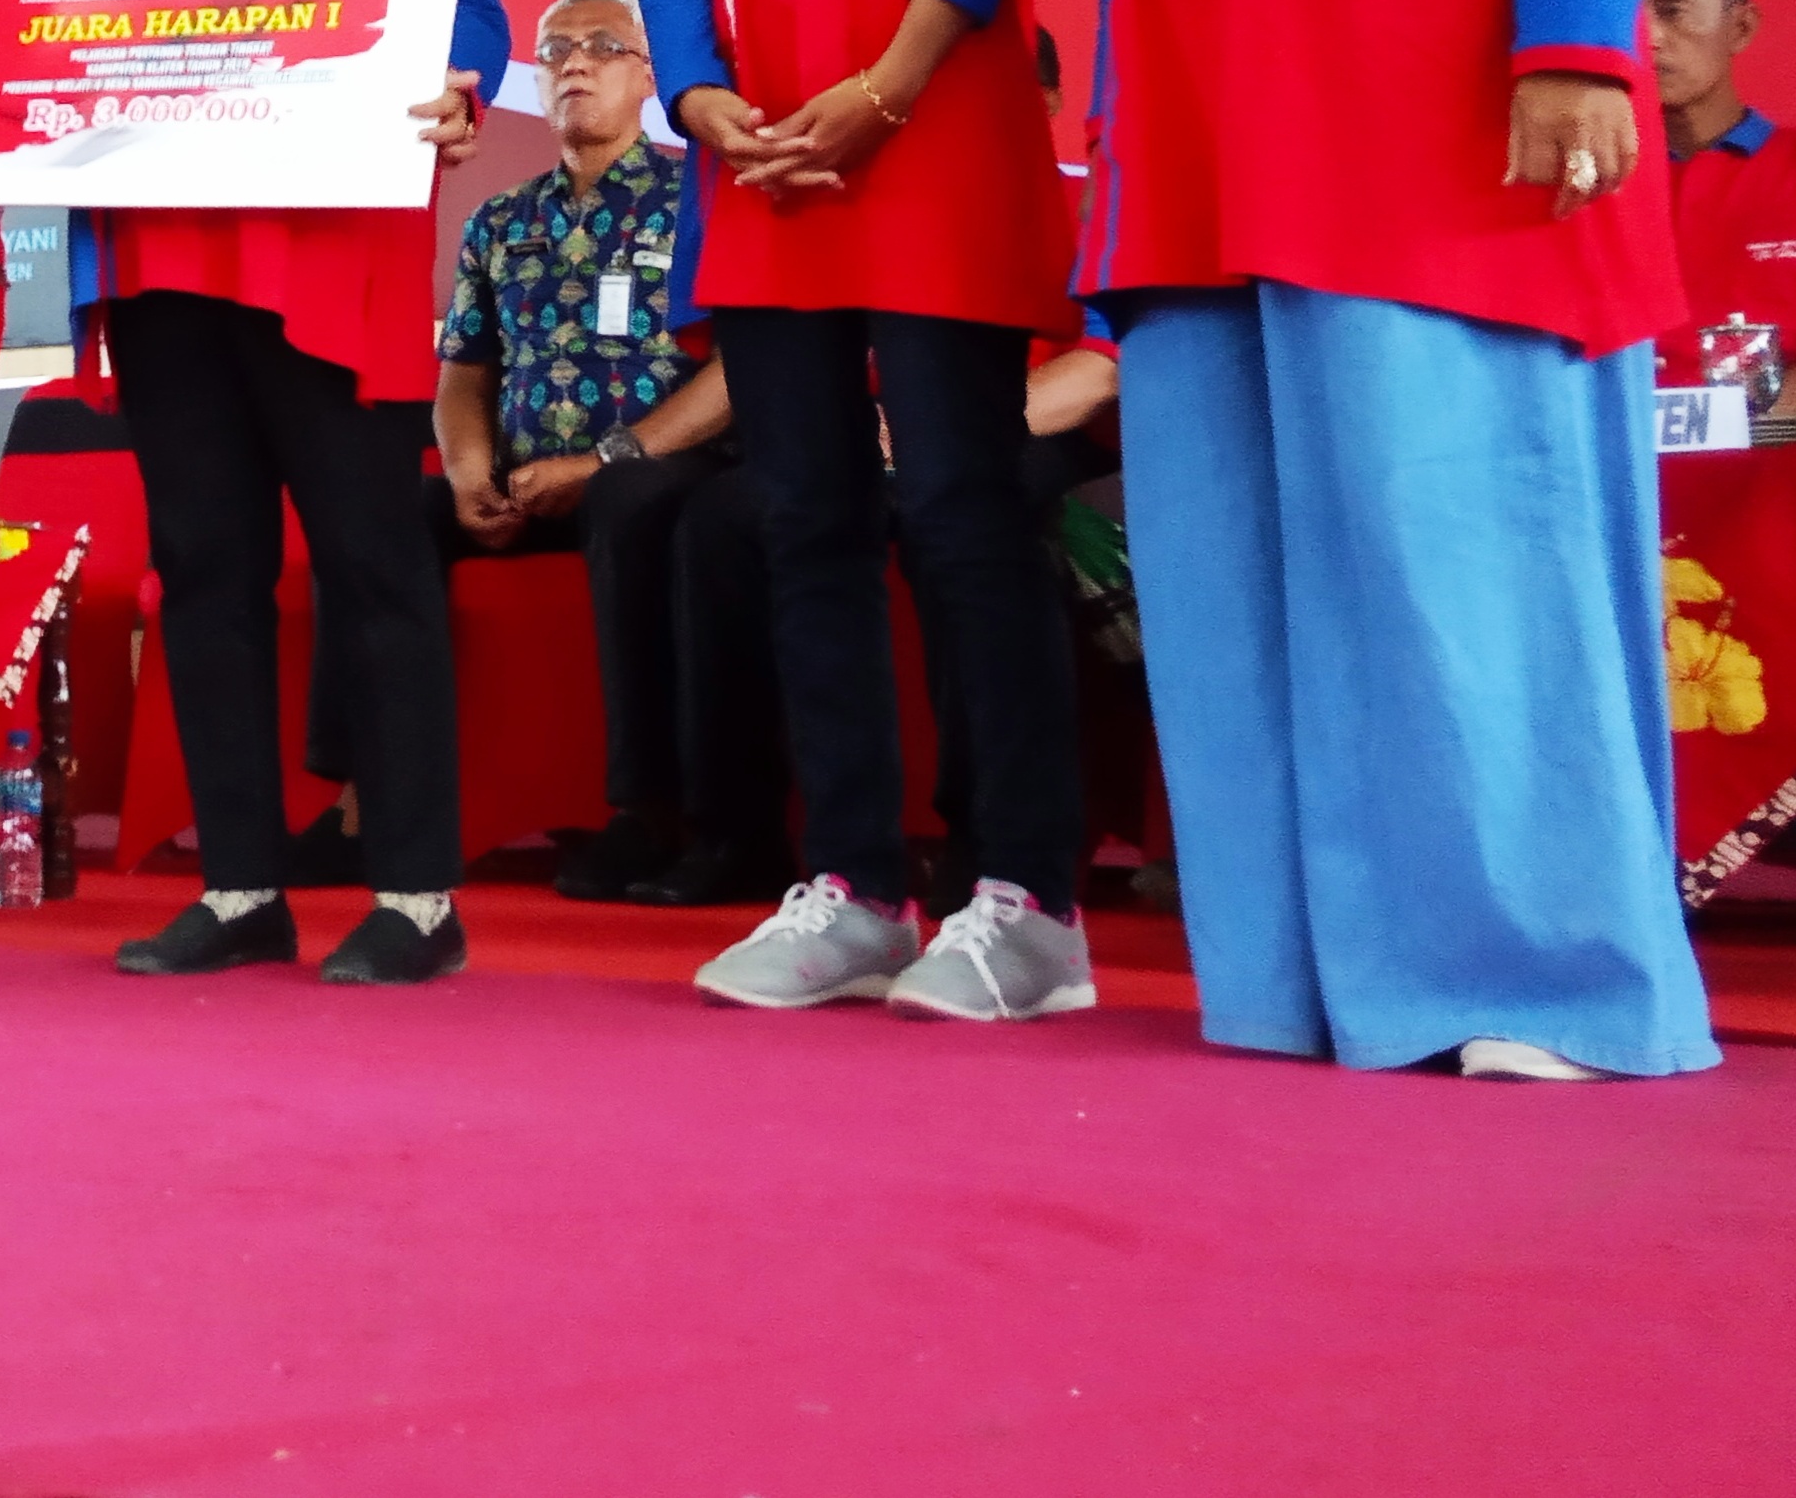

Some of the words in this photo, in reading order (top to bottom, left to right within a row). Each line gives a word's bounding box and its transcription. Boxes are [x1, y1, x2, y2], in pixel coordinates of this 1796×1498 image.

[18, 12, 133, 45] JUARA
[142, 2, 317, 39] HARAPAN
[325, 1, 342, 30] I
[23, 98, 86, 139] Rp.
